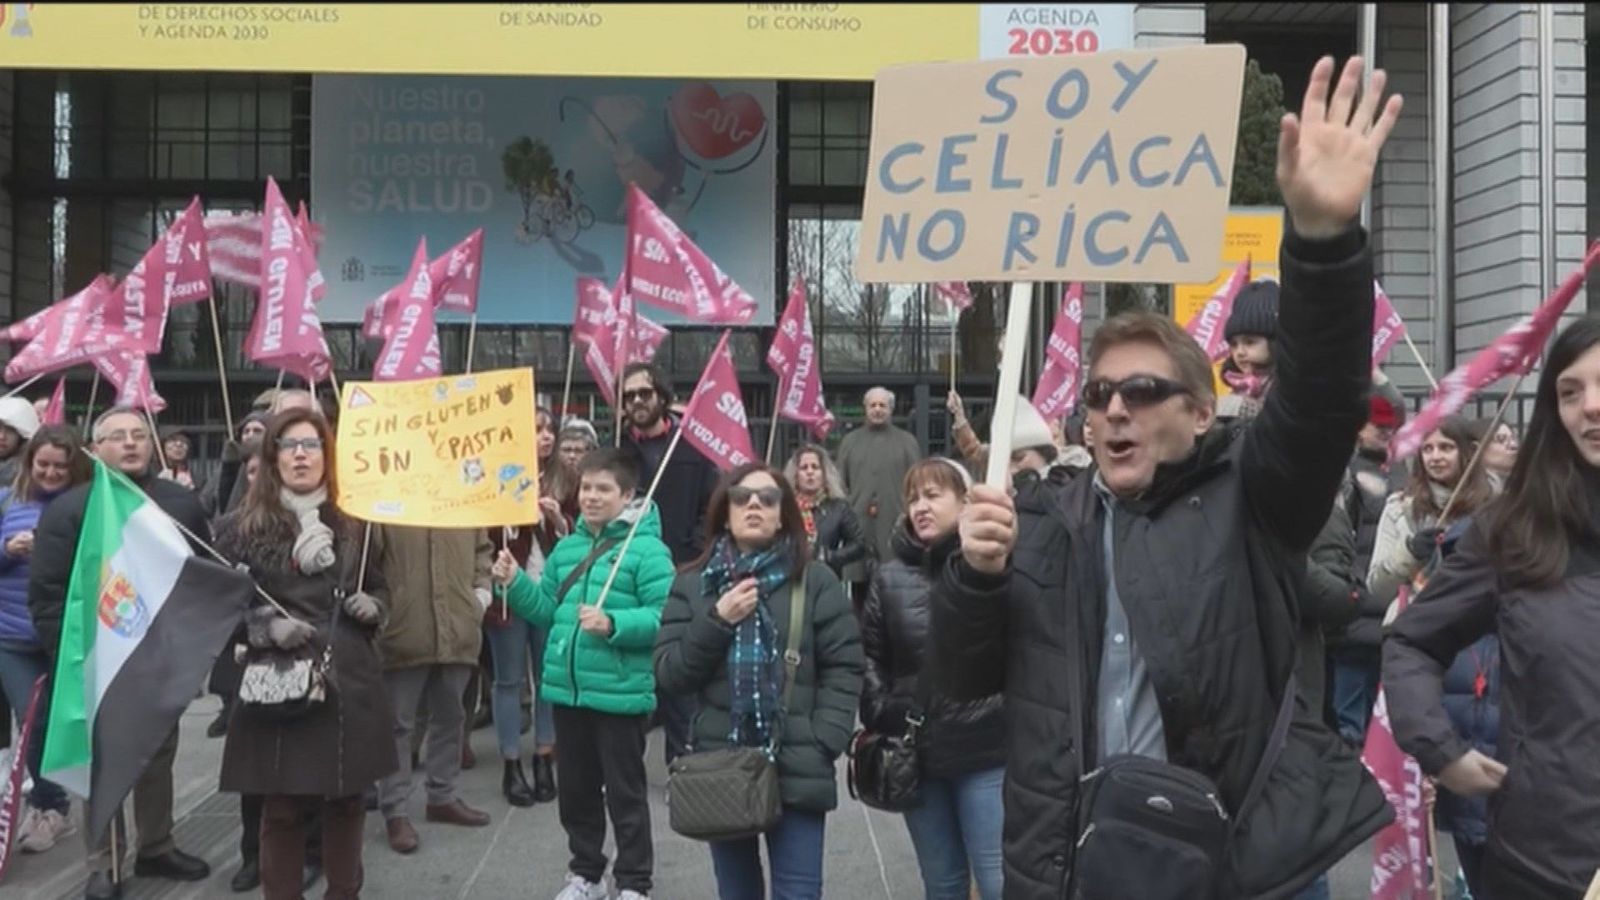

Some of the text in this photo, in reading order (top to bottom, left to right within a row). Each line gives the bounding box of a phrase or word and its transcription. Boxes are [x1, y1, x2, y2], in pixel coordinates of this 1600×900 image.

[138, 6, 340, 23] DE DERECHOS SOCIALES
[500, 12, 603, 27] DE SANIDAD
[747, 16, 861, 31] DE CONSUMO
[1006, 8, 1100, 26] AGENDA
[138, 25, 269, 40] Y AGENDA 2030
[1008, 28, 1098, 55] 2030
[350, 81, 485, 110] Nuestro
[980, 58, 1158, 124] SOY
[349, 112, 496, 152] planeta,
[348, 149, 478, 177] nuestra
[347, 179, 494, 213] SALUD
[876, 209, 966, 264] NO
[352, 414, 398, 438] SIN
[406, 393, 491, 431] GLUTEN
[427, 429, 439, 446] Y
